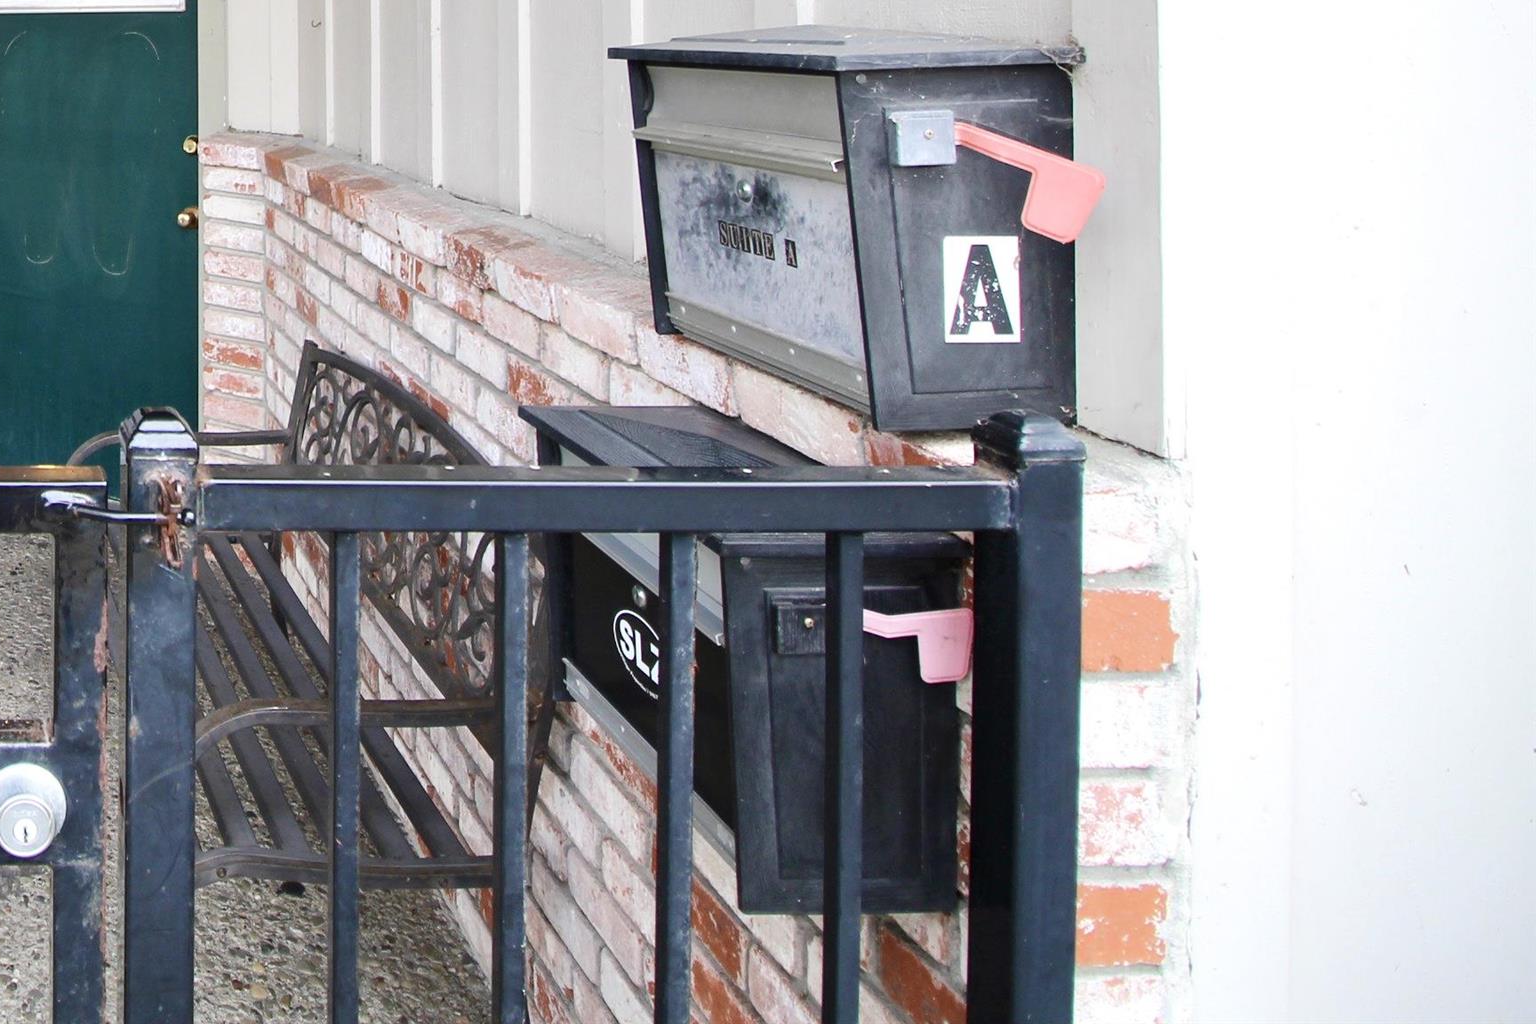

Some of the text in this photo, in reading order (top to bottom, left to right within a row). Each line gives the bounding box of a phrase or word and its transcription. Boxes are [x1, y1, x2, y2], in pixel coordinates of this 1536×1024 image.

[719, 221, 797, 267] SUITE A
[950, 244, 1014, 335] A
